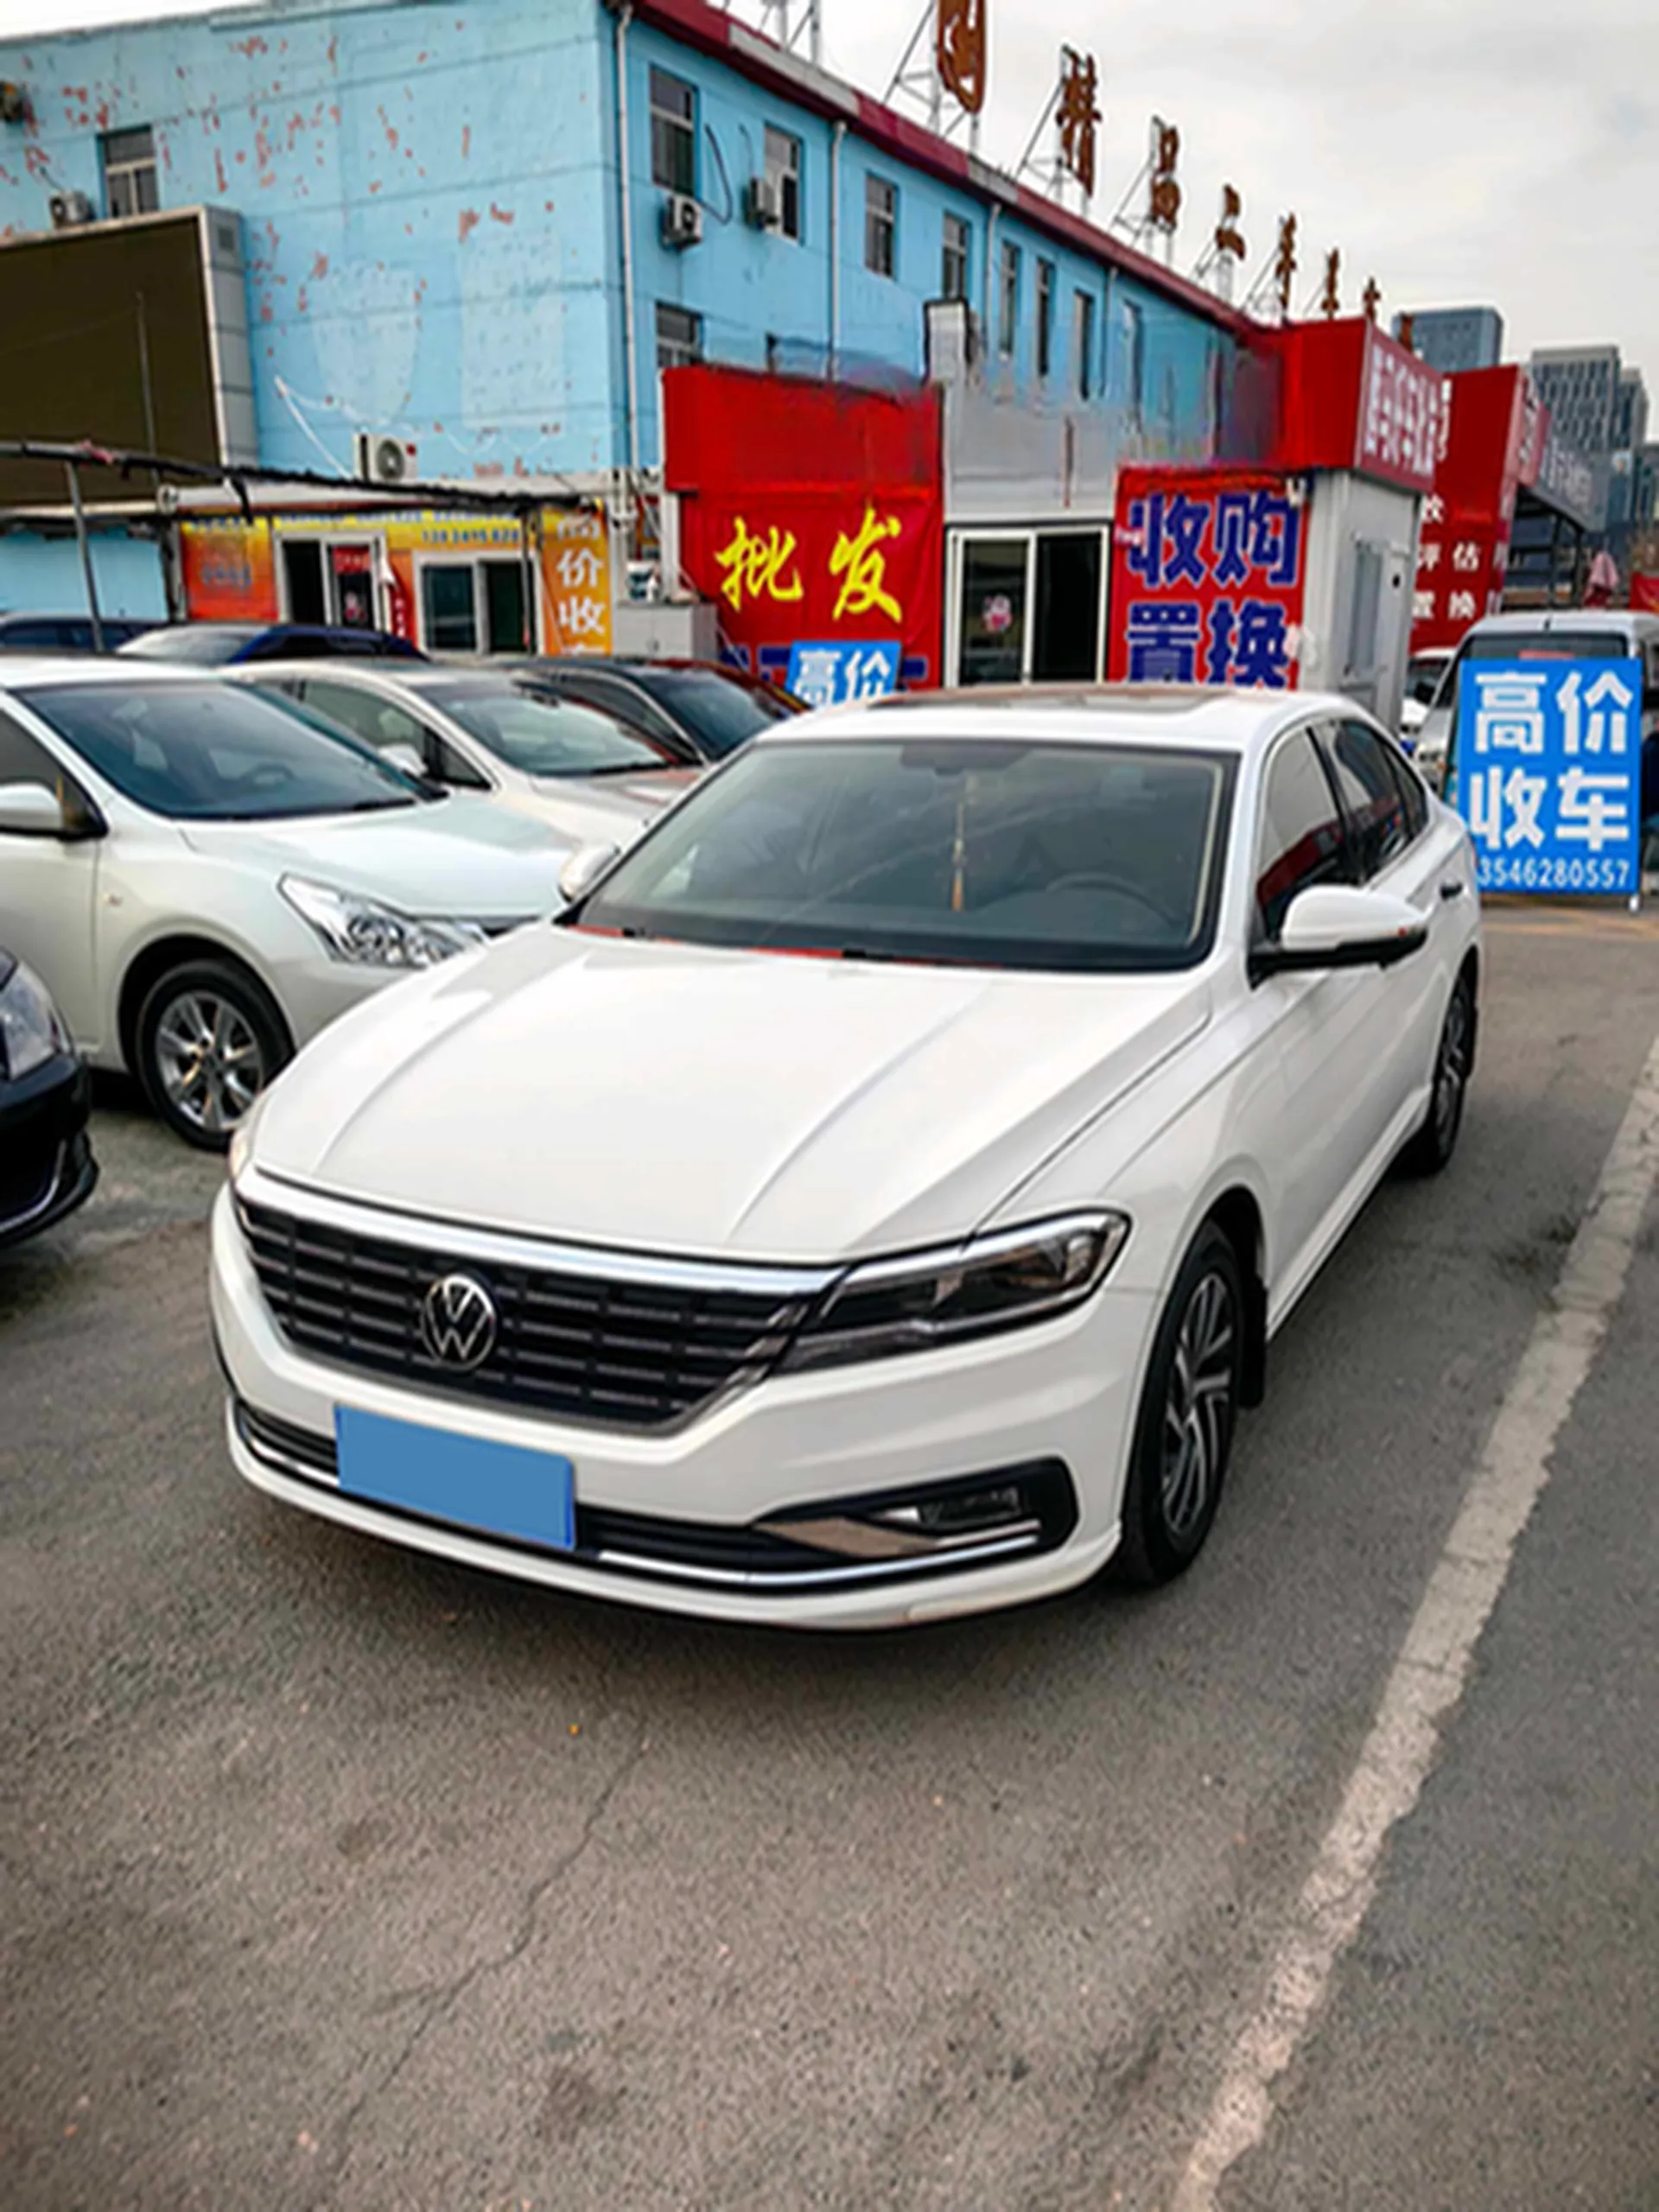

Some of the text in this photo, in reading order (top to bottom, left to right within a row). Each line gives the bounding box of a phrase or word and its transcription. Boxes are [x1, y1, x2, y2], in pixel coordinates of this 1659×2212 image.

[715, 506, 903, 624] 批发
[1128, 489, 1299, 588] 收购
[1126, 597, 1291, 689] 置换
[1474, 671, 1633, 754] 高价
[1470, 766, 1630, 852] 收车
